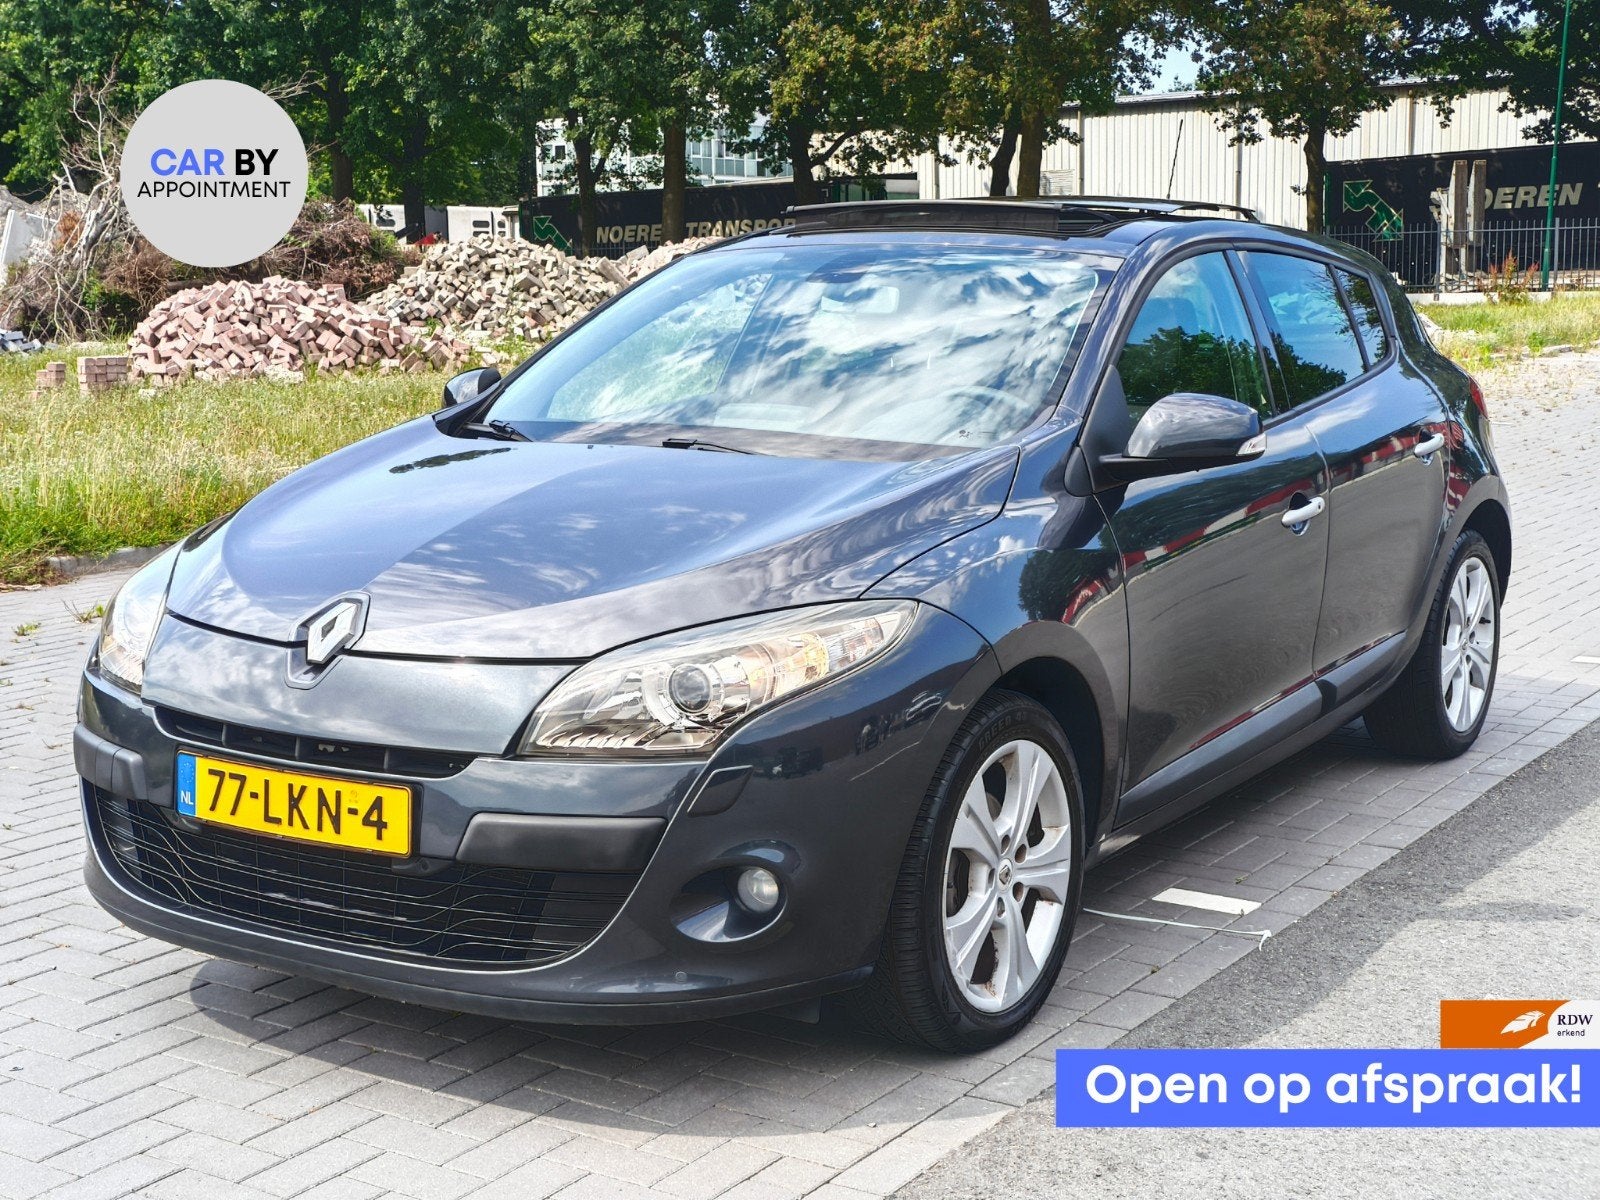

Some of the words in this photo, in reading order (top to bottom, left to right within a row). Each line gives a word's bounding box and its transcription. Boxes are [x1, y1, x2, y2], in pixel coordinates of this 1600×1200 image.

[596, 224, 663, 244] NOERE
[180, 790, 195, 806] NL
[208, 768, 388, 841] 77-LKN-4
